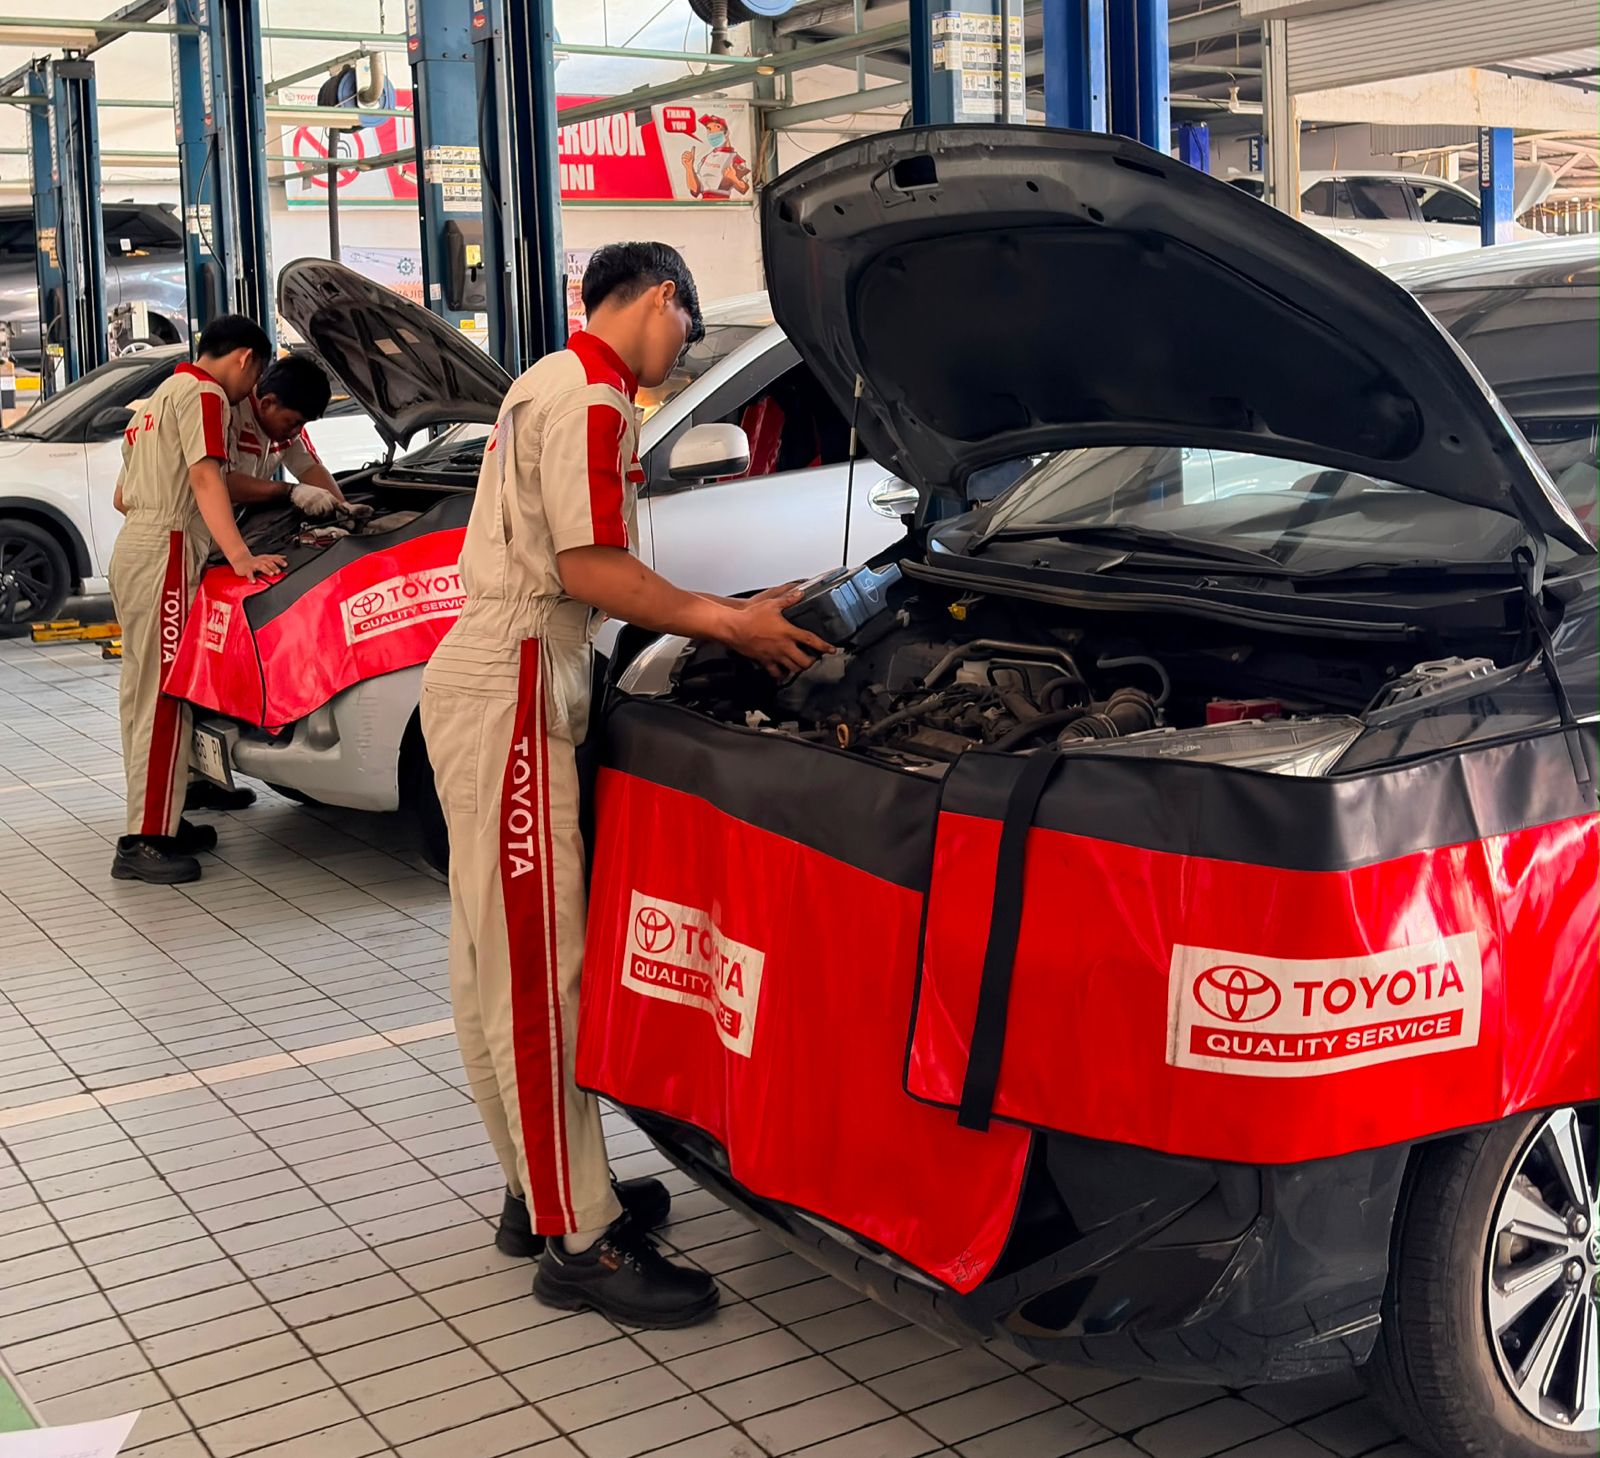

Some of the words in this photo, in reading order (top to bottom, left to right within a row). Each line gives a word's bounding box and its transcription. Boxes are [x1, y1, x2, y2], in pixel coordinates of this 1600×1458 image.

[296, 93, 317, 101] TOYO
[667, 109, 690, 119] THANK
[671, 121, 687, 131] YOU
[1481, 134, 1490, 181] ROTARY
[387, 573, 460, 602] TOYOT
[162, 587, 180, 663] TOYOTA
[360, 607, 419, 631] QUALITY
[421, 597, 467, 613] SERVIC
[508, 736, 534, 879] TOYOTA
[634, 960, 710, 993] QUALITY
[681, 923, 745, 998] TOTA
[1293, 959, 1465, 1017] TOYOTA
[1206, 1033, 1339, 1057] QUALITY
[1345, 1016, 1451, 1050] SERVICE
